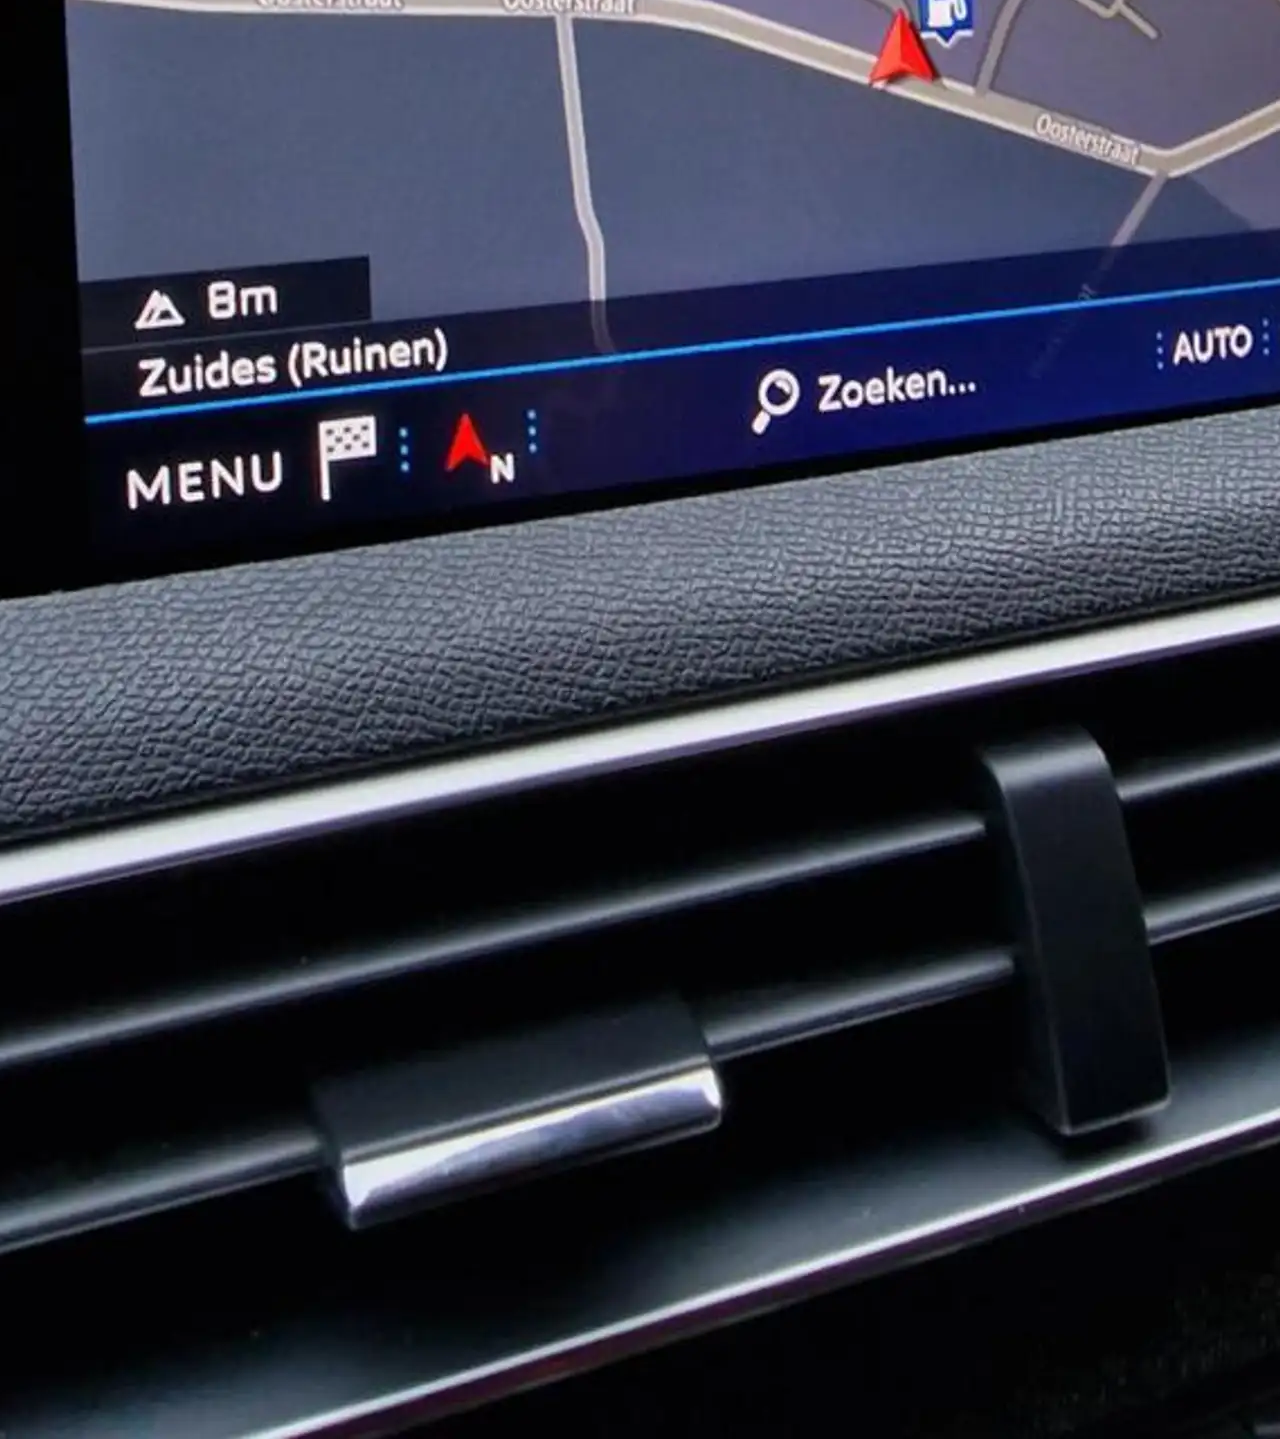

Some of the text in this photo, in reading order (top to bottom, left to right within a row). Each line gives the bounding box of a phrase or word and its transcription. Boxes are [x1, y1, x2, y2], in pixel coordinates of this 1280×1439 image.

[1036, 112, 1140, 166] Oosterstraat
[207, 281, 278, 320] 8m
[137, 328, 448, 398] Zuides (Ruinen)
[1173, 324, 1253, 363] AUTO
[817, 366, 977, 413] Zoeken...
[126, 450, 284, 509] MENU
[489, 453, 516, 484] N
